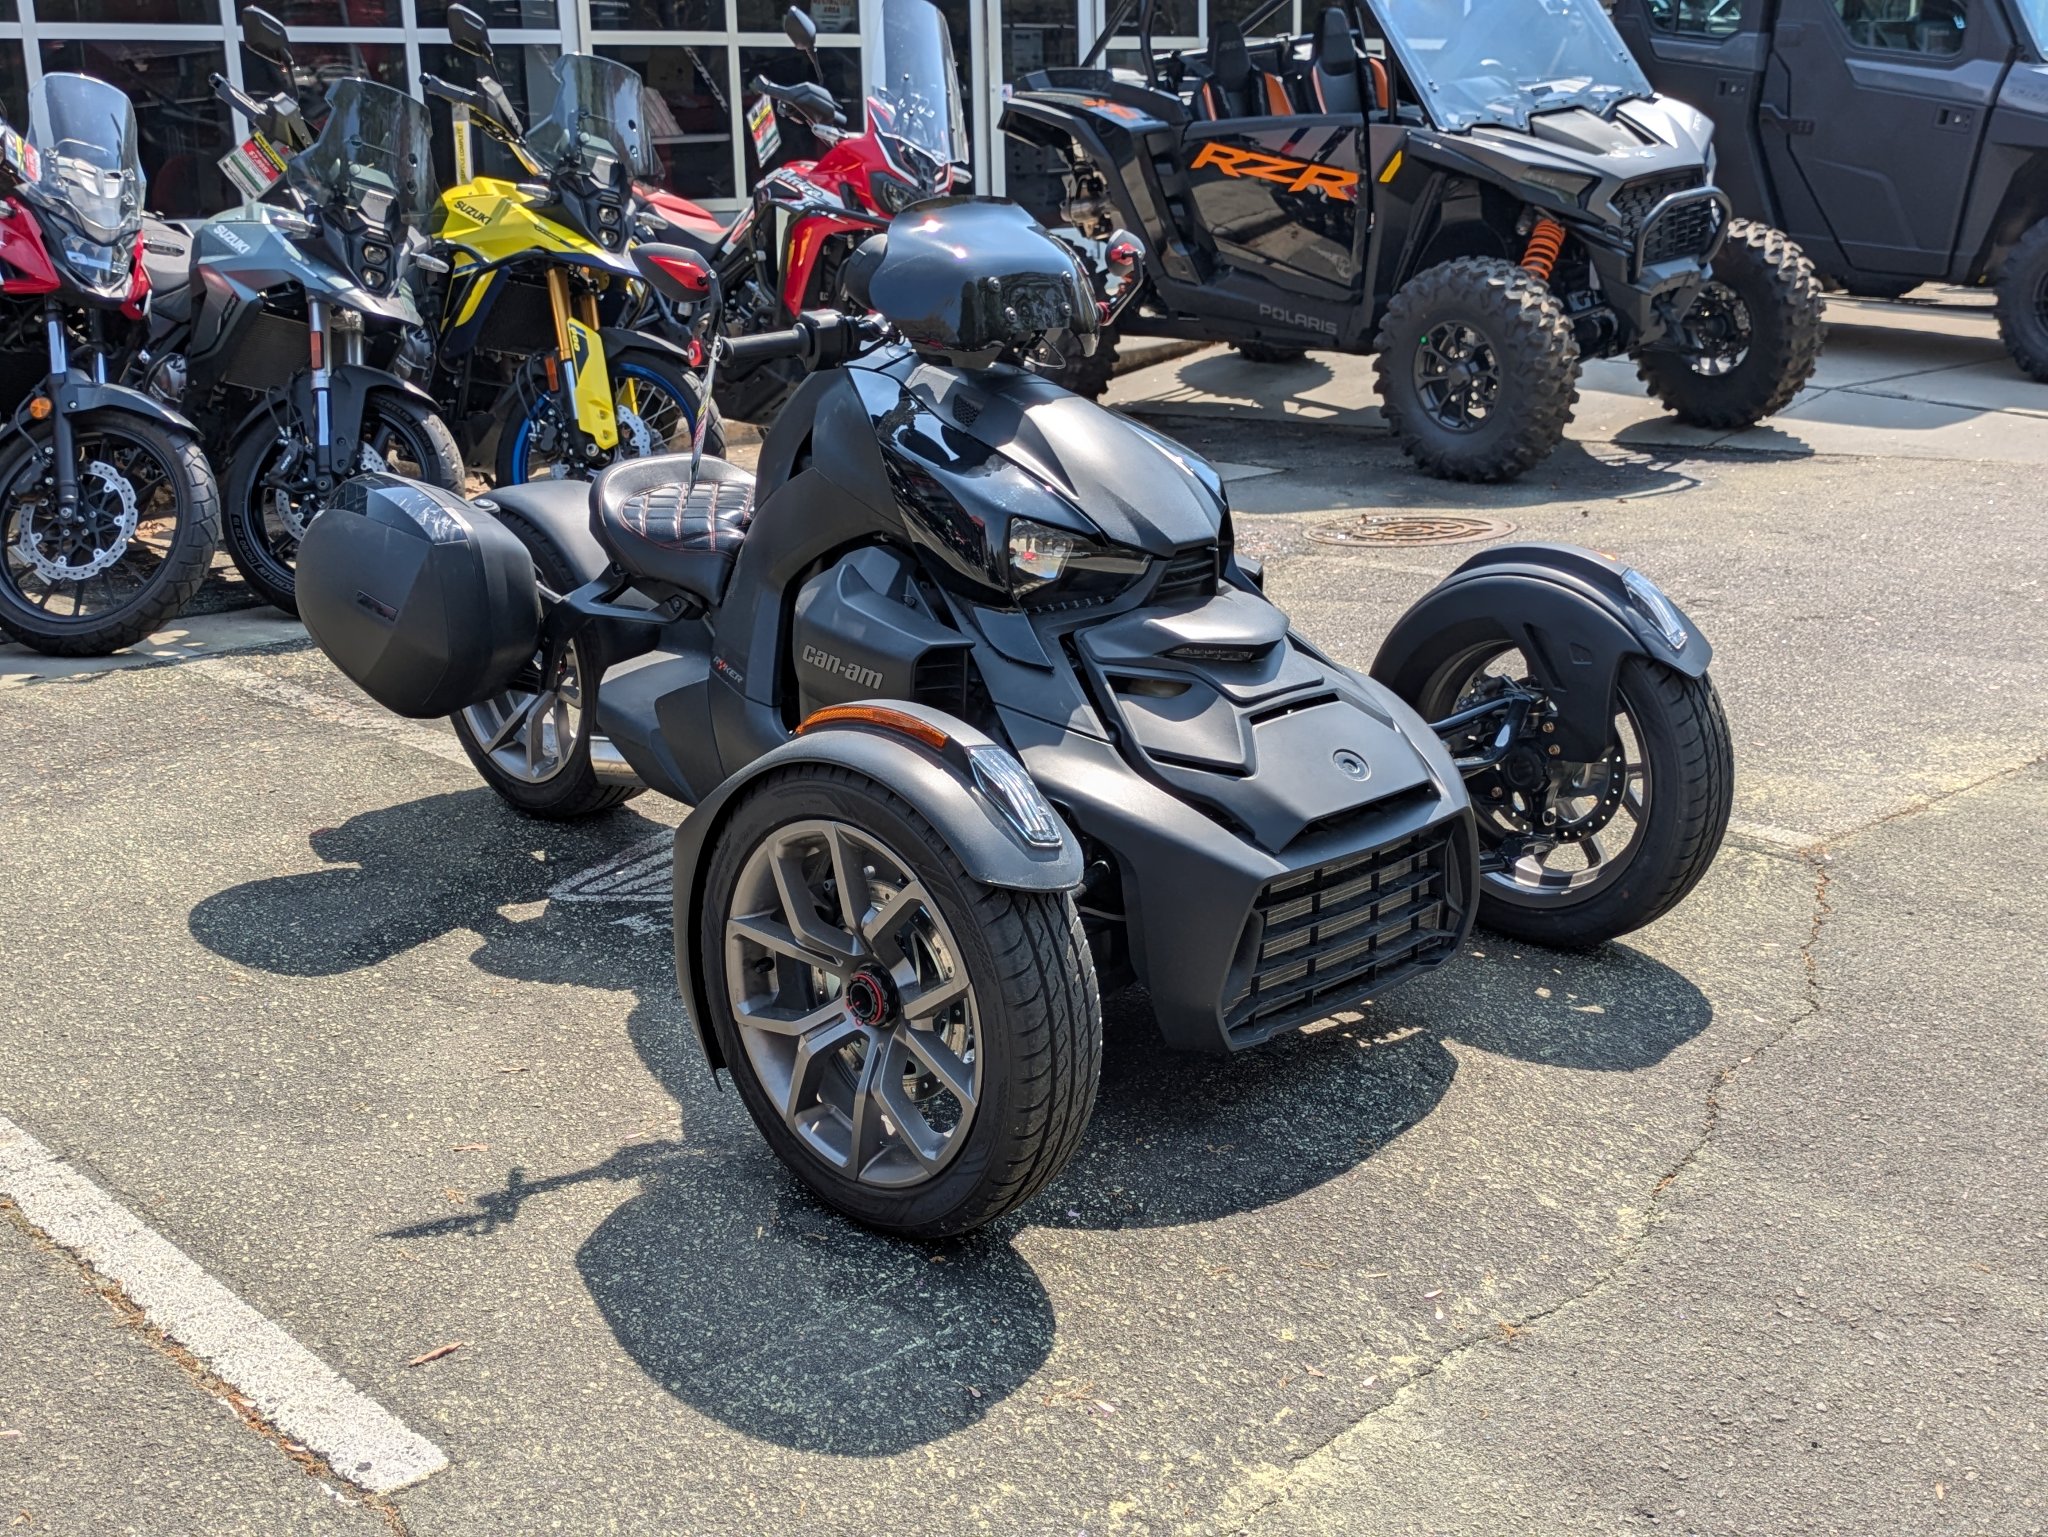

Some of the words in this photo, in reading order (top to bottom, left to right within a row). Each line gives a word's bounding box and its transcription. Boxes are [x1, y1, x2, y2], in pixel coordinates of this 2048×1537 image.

[1191, 142, 1360, 201] RZR
[453, 200, 492, 226] SUZUKI
[213, 224, 251, 255] SUZUKI
[1259, 303, 1338, 335] POLARIS
[258, 566, 295, 592] ICHELIN
[713, 655, 743, 684] RYKER
[802, 645, 883, 690] can-am
